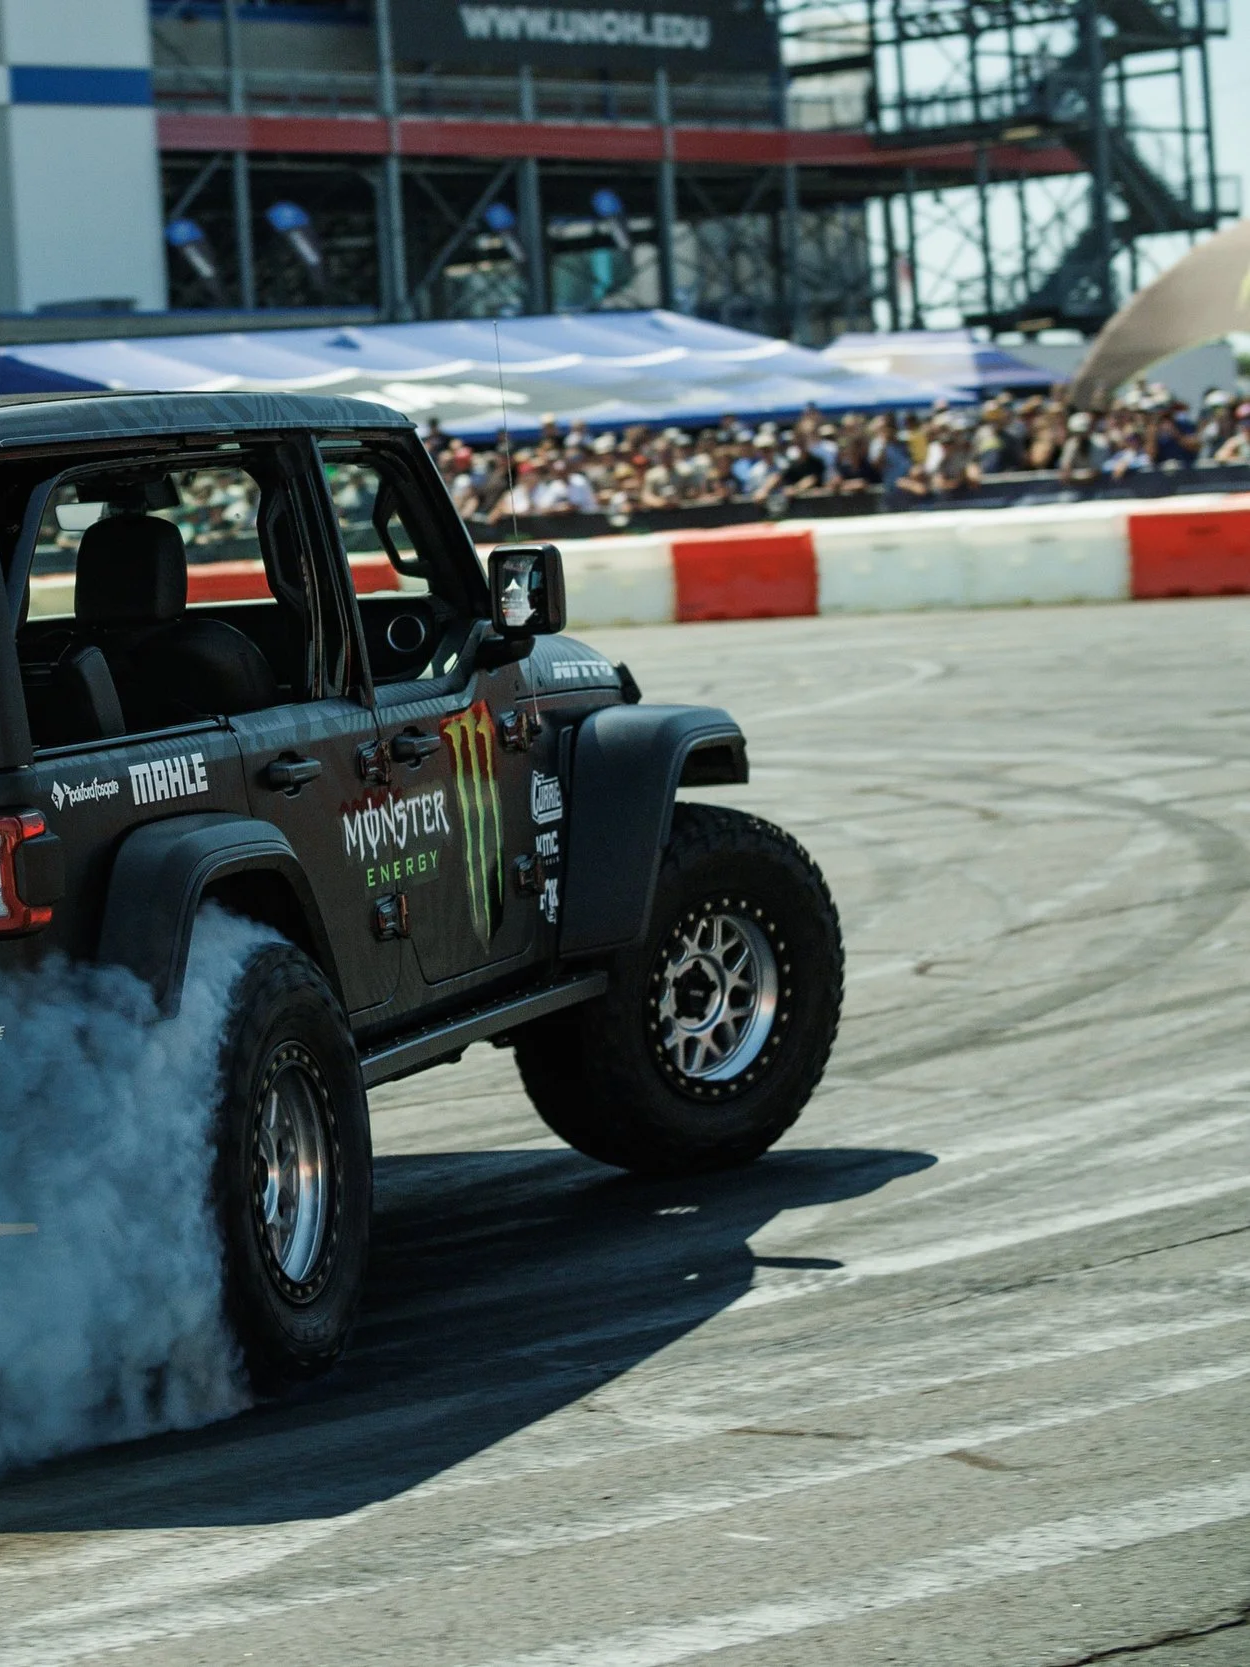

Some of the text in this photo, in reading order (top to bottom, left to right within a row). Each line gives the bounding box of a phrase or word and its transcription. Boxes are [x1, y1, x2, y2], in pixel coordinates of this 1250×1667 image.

[459, 6, 711, 49] WWW.UNOH.EDU
[128, 752, 208, 806] MAHLE
[343, 789, 450, 861] MONSTER
[536, 830, 559, 857] KMC
[366, 850, 438, 888] ENERGY
